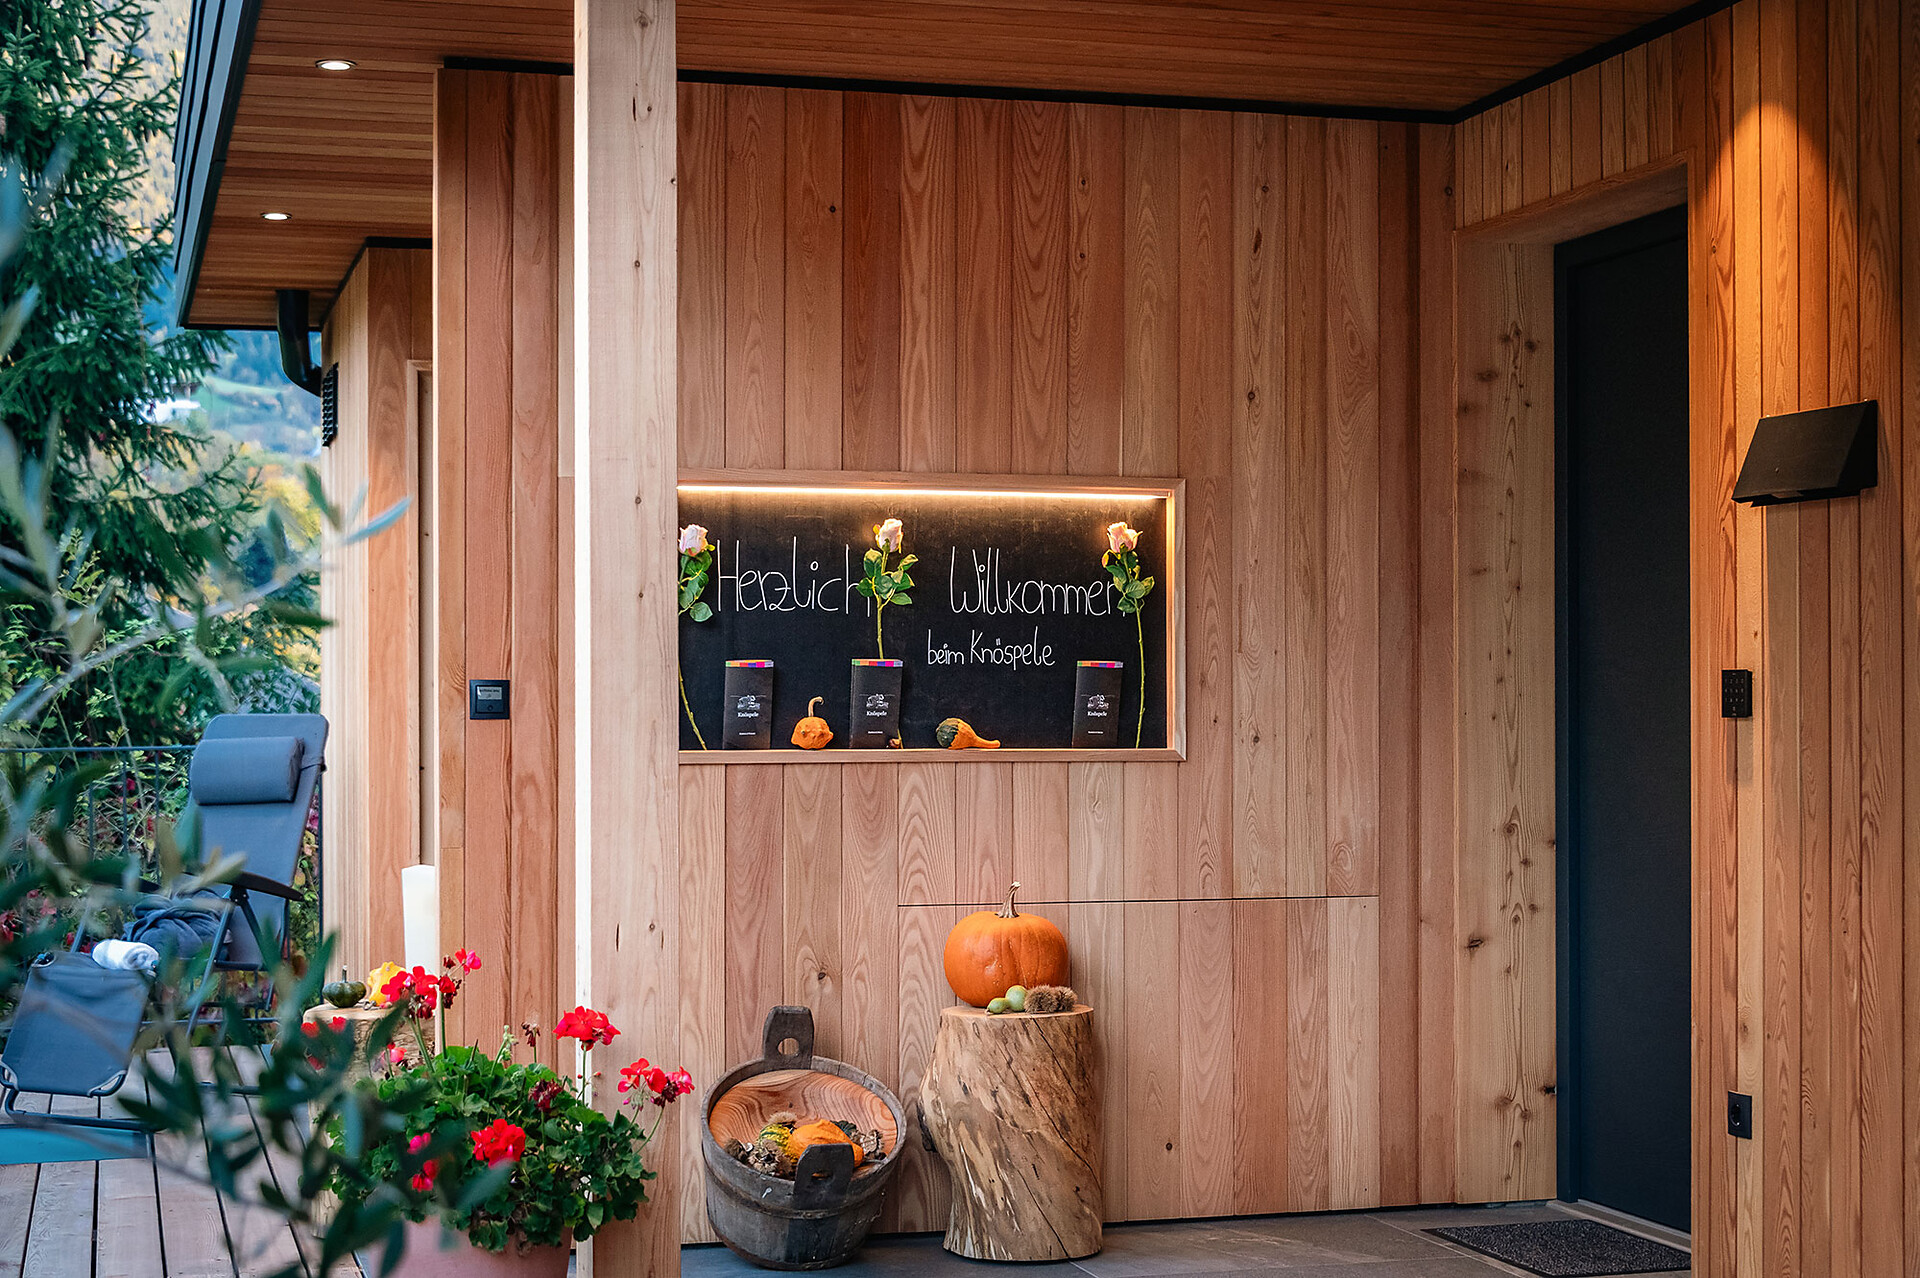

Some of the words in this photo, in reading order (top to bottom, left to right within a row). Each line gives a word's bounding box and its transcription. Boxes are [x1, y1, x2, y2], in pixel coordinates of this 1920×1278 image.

[717, 536, 870, 617] Herzlich
[927, 629, 965, 665] beim
[970, 626, 1056, 670] Knöspele
